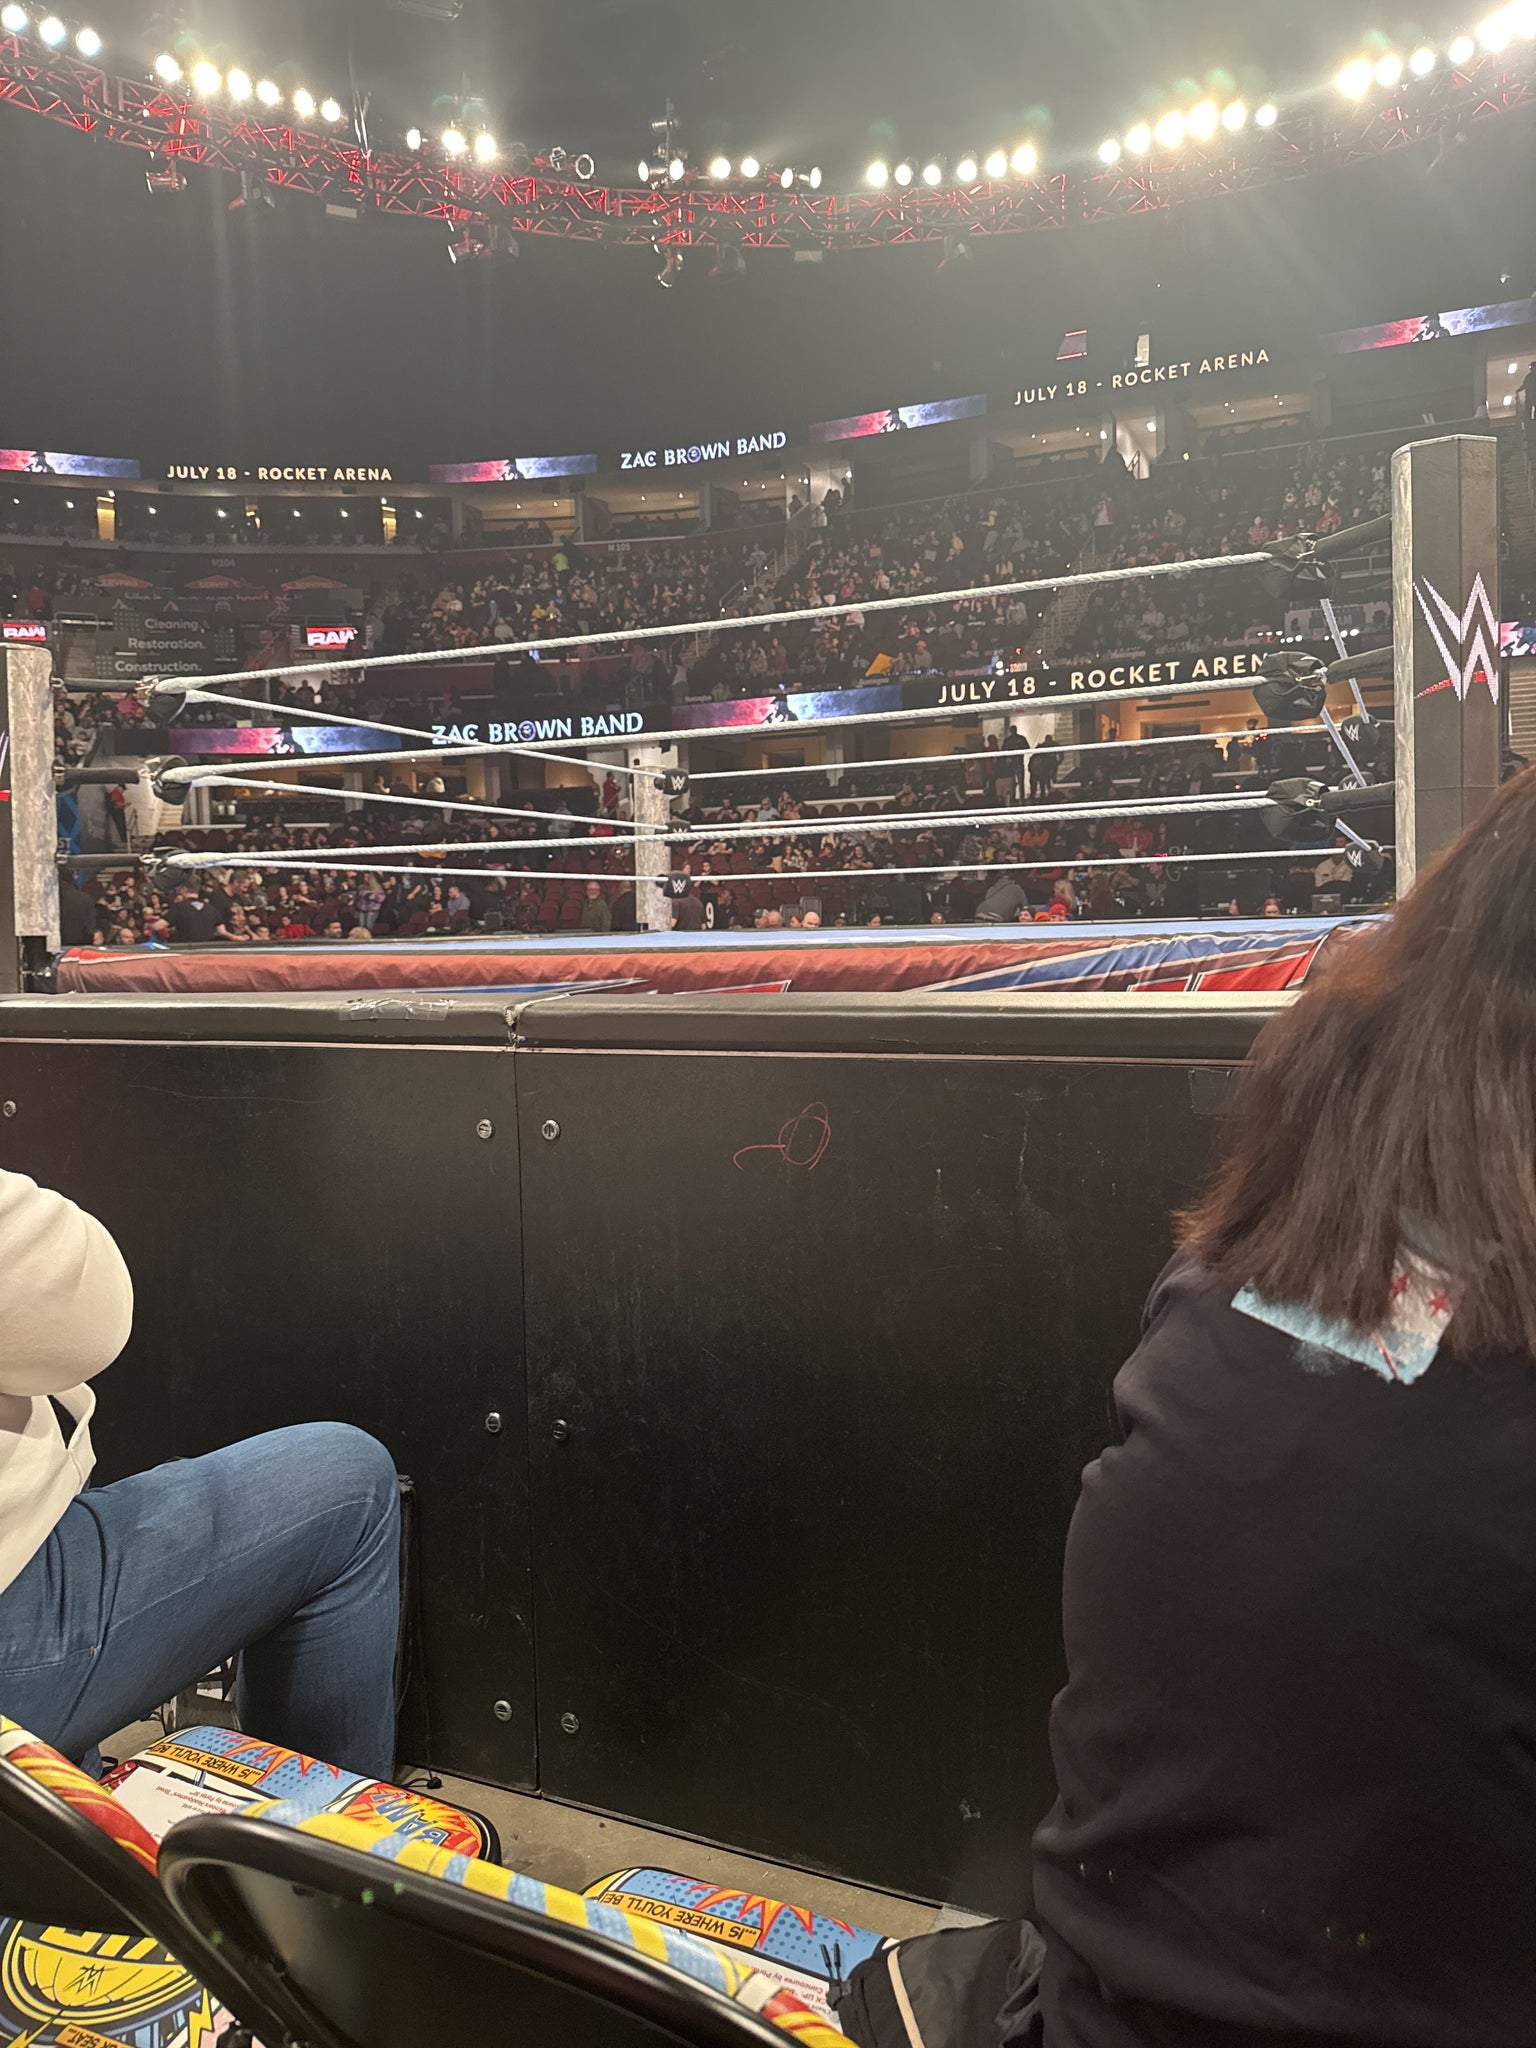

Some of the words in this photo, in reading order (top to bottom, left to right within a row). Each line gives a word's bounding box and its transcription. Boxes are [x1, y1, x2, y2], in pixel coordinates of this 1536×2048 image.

[1014, 384, 1058, 405] JULY
[1066, 379, 1088, 397] 18
[1112, 362, 1191, 389] ROCKET
[1199, 348, 1271, 375] ARENA
[620, 451, 657, 470] ZAC
[664, 440, 730, 466] BROWN
[736, 431, 787, 456] BAND
[167, 465, 208, 480] JULY
[216, 465, 237, 480] 18
[258, 467, 328, 481] ROCKET
[333, 467, 392, 482] ARENA
[3, 625, 46, 638] RAW
[307, 629, 357, 647] RAW
[128, 638, 206, 650] Restoration.
[114, 661, 202, 673] Construction.
[938, 681, 995, 704] JULY
[1007, 677, 1036, 696] 18
[1070, 660, 1181, 692] ROCKET
[1192, 652, 1269, 678] AREN
[431, 724, 479, 745] ZAC
[489, 718, 572, 743] BROWN
[581, 712, 643, 737] BAND
[173, 1747, 202, 1765] YOU'LL
[200, 1756, 239, 1777] WHERE
[370, 1792, 449, 1847] BAM!
[628, 1897, 671, 1918] YOU'LL
[674, 1911, 724, 1934] WHERE
[784, 1976, 824, 1995] Concourse
